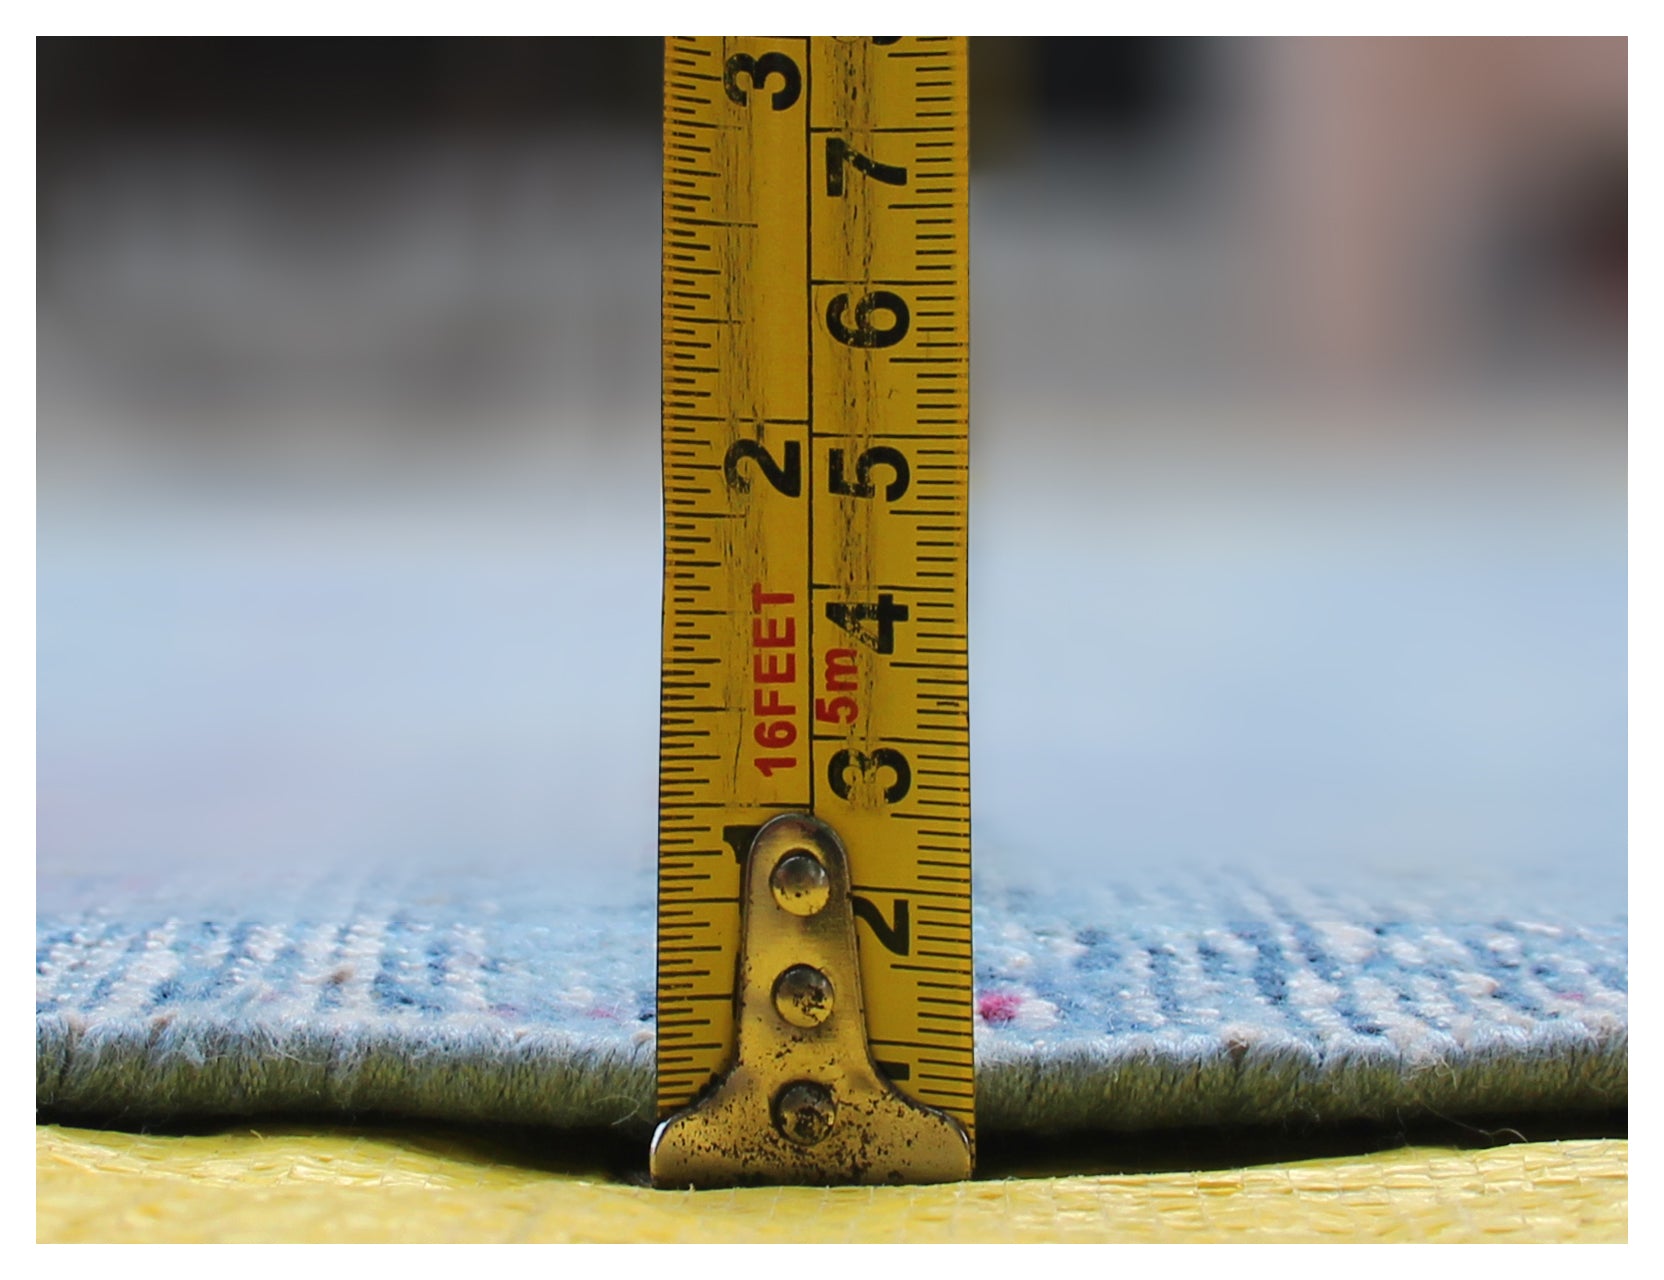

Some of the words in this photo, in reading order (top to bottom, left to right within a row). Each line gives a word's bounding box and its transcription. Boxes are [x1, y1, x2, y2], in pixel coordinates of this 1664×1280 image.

[723, 52, 802, 111] 3
[826, 137, 907, 197] 7
[826, 291, 910, 348] 6
[724, 439, 801, 498] 2
[828, 446, 910, 502] 5
[825, 594, 909, 654] 4
[752, 582, 797, 777] 16FEET
[815, 648, 859, 724] 5m
[827, 748, 911, 803] 3
